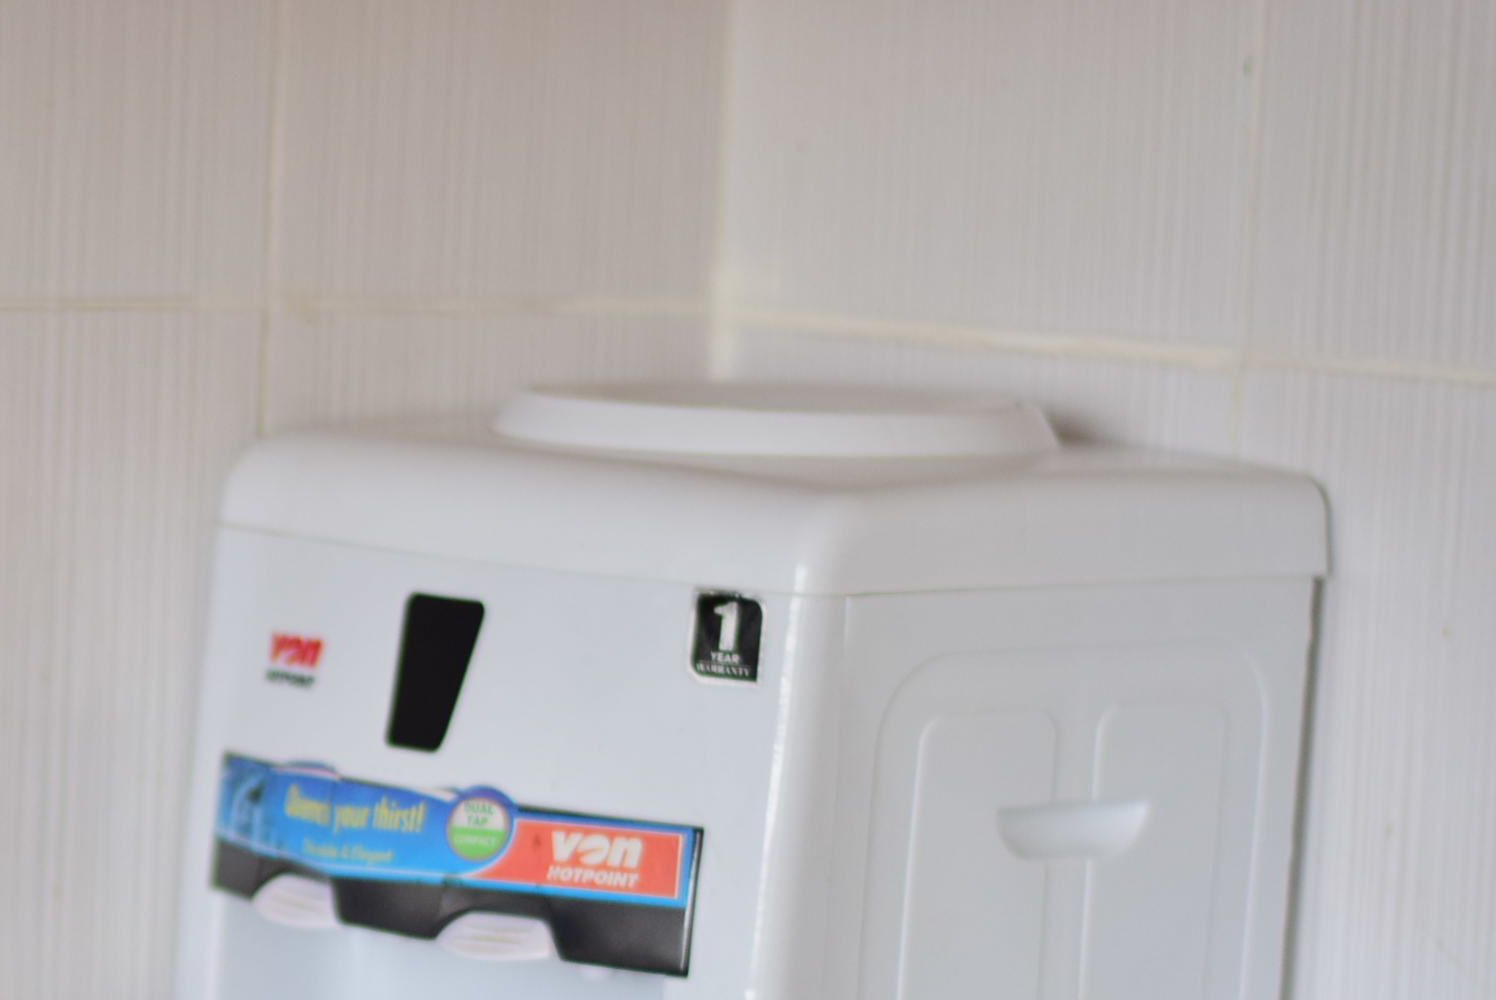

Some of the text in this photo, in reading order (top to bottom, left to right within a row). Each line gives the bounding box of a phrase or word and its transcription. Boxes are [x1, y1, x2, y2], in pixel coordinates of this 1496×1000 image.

[713, 601, 741, 652] 1
[710, 651, 742, 666] YEAR
[333, 804, 370, 834] your
[550, 829, 643, 868] von
[546, 864, 640, 889] HOTPOINT
